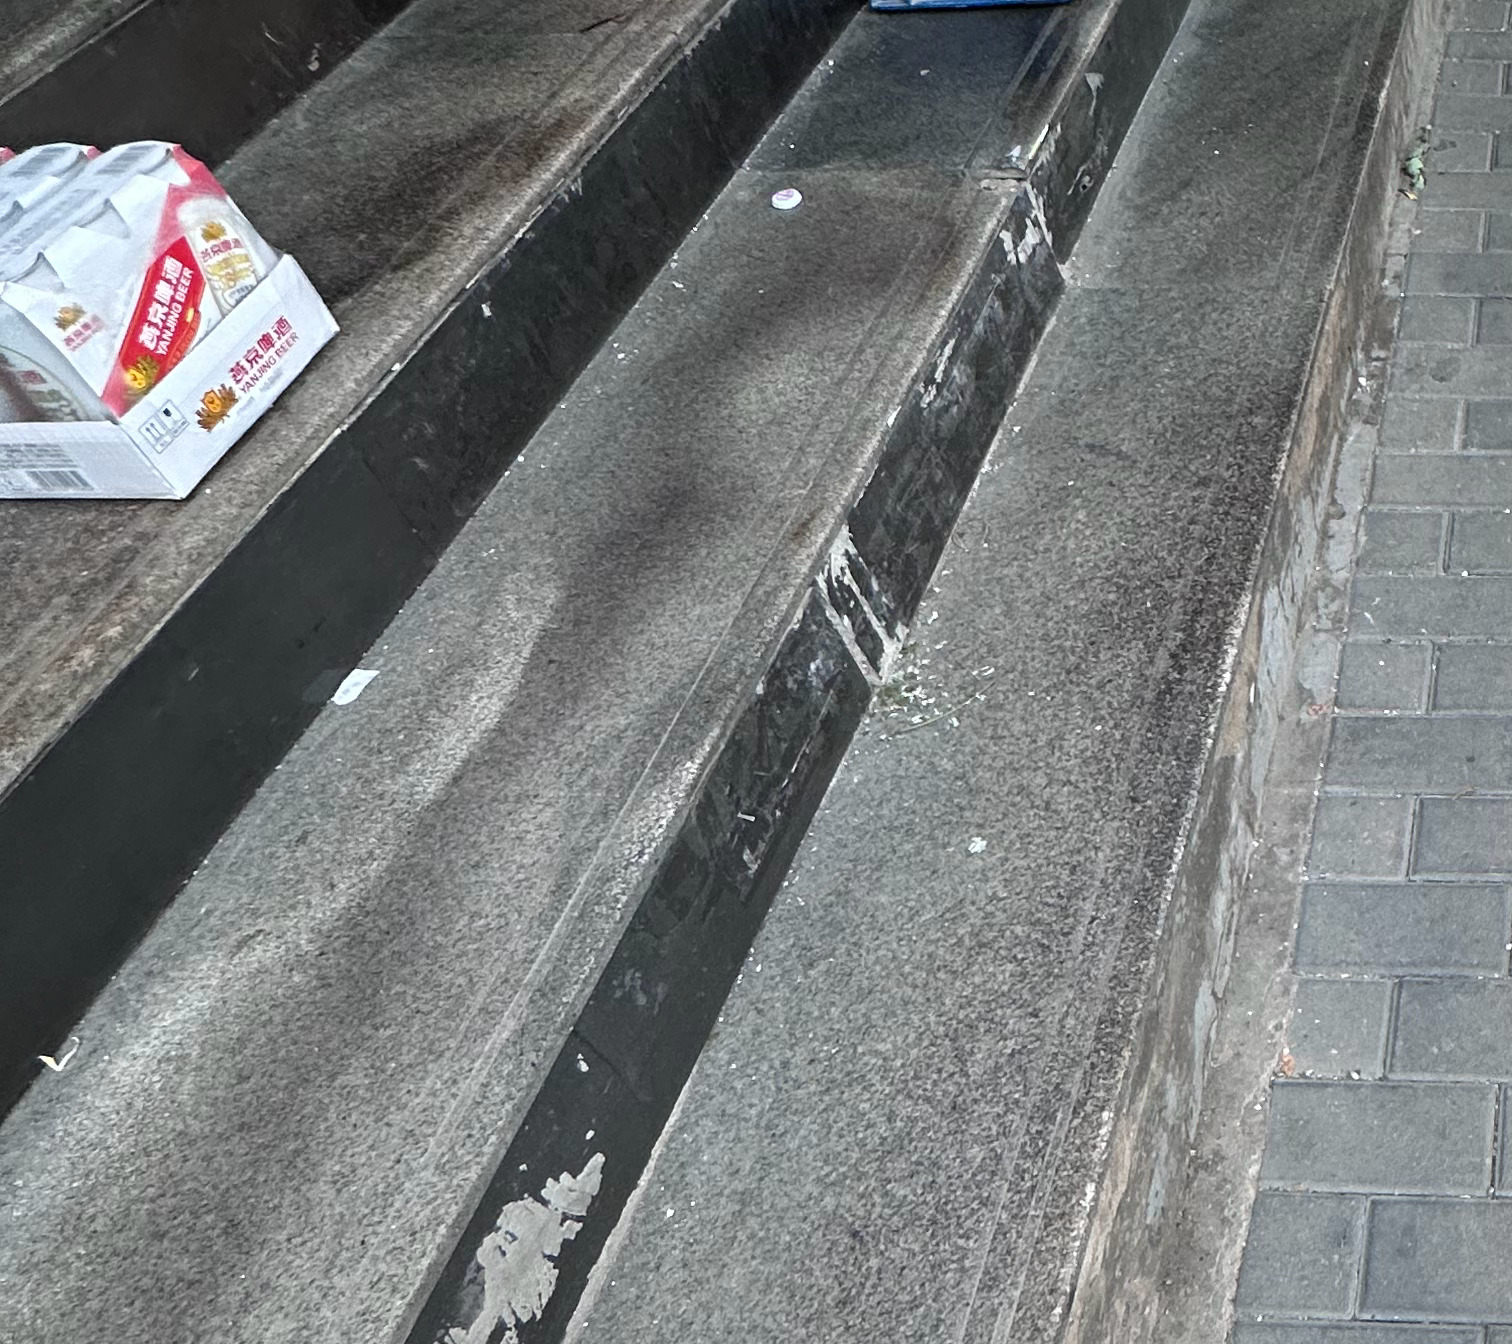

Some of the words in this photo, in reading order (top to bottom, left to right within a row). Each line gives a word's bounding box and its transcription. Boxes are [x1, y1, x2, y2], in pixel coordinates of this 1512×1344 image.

[138, 255, 184, 352] 燕京啤酒
[155, 299, 183, 356] YANJING
[174, 266, 195, 305] BEER
[227, 315, 293, 385] 燕京啤酒
[238, 354, 278, 394] YANJING
[274, 330, 300, 359] BEER
